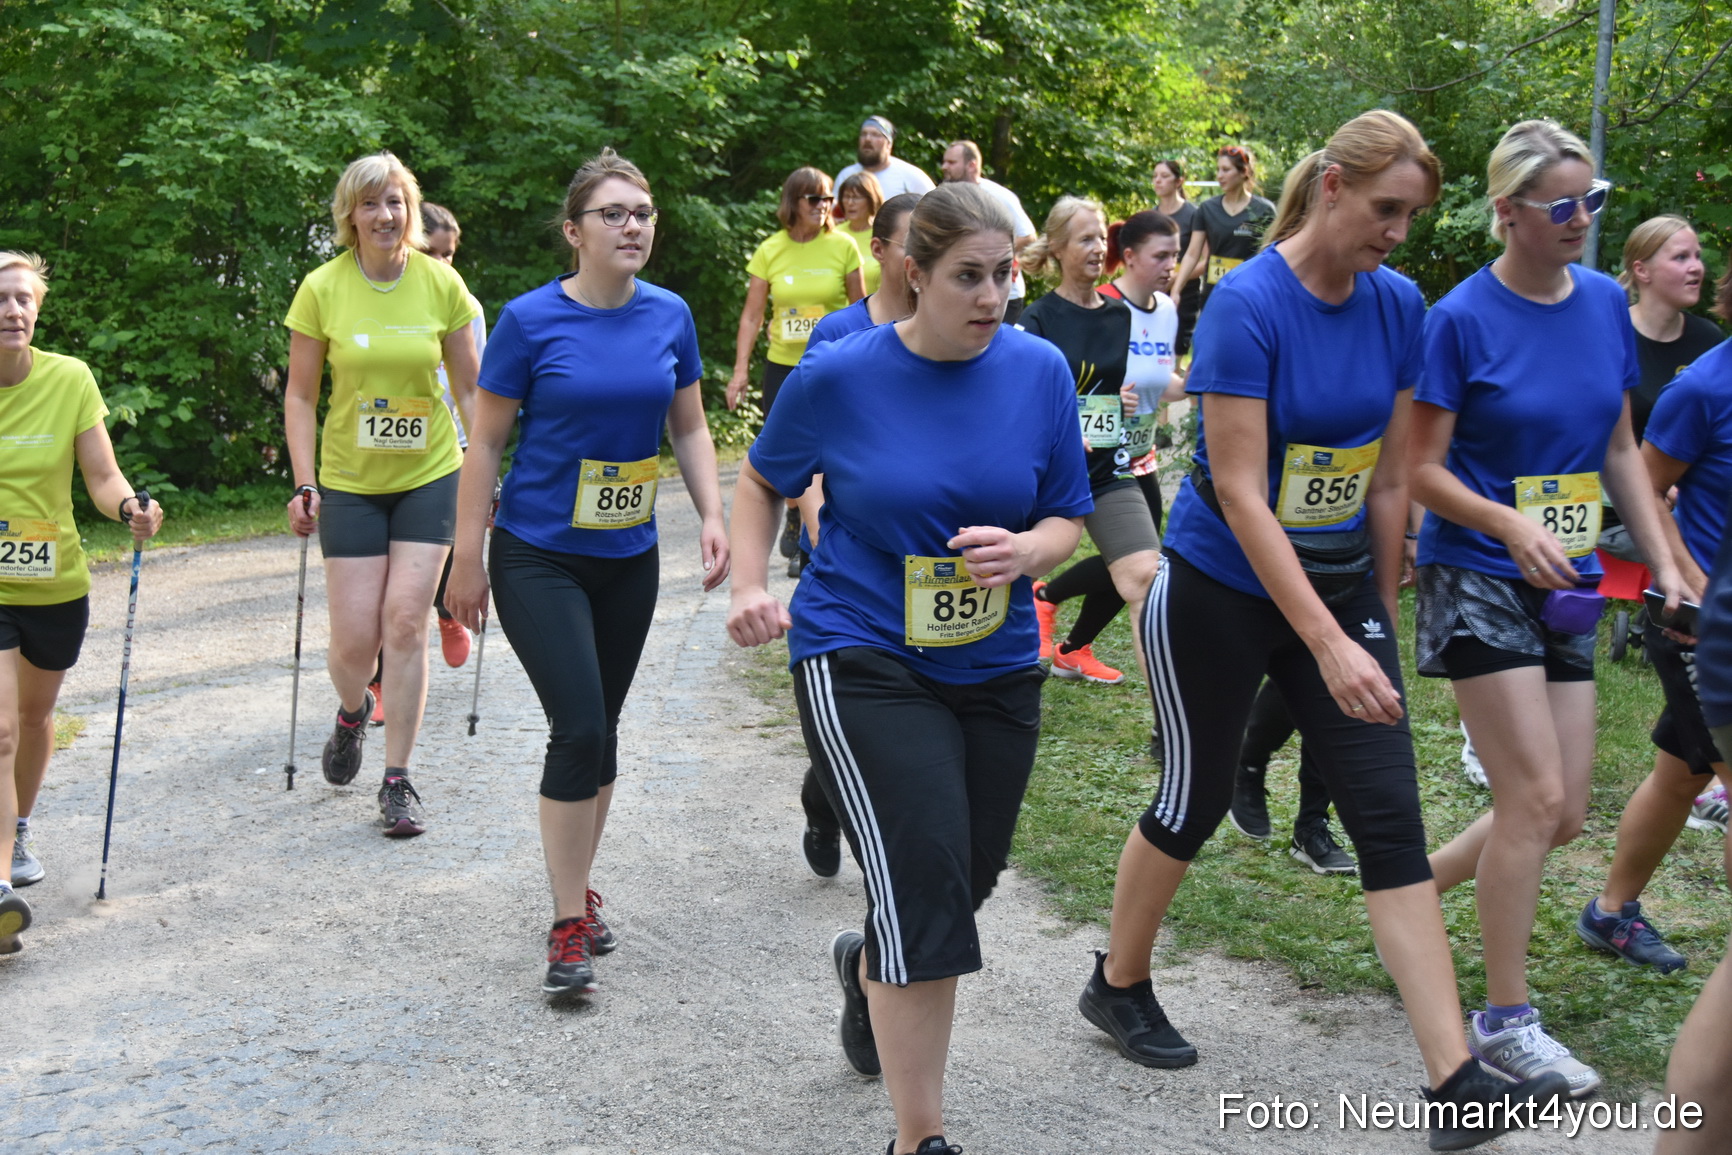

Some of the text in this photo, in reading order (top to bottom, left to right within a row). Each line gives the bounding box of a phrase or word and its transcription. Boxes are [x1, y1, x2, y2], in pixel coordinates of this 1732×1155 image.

[366, 416, 422, 438] 1266
[1081, 414, 1114, 432] 745
[597, 484, 643, 511] 868
[1304, 474, 1359, 506] 856
[1543, 503, 1588, 534] 852
[0, 541, 50, 565] 254
[933, 587, 992, 622] 857
[927, 611, 998, 631] Holfelder Ramona
